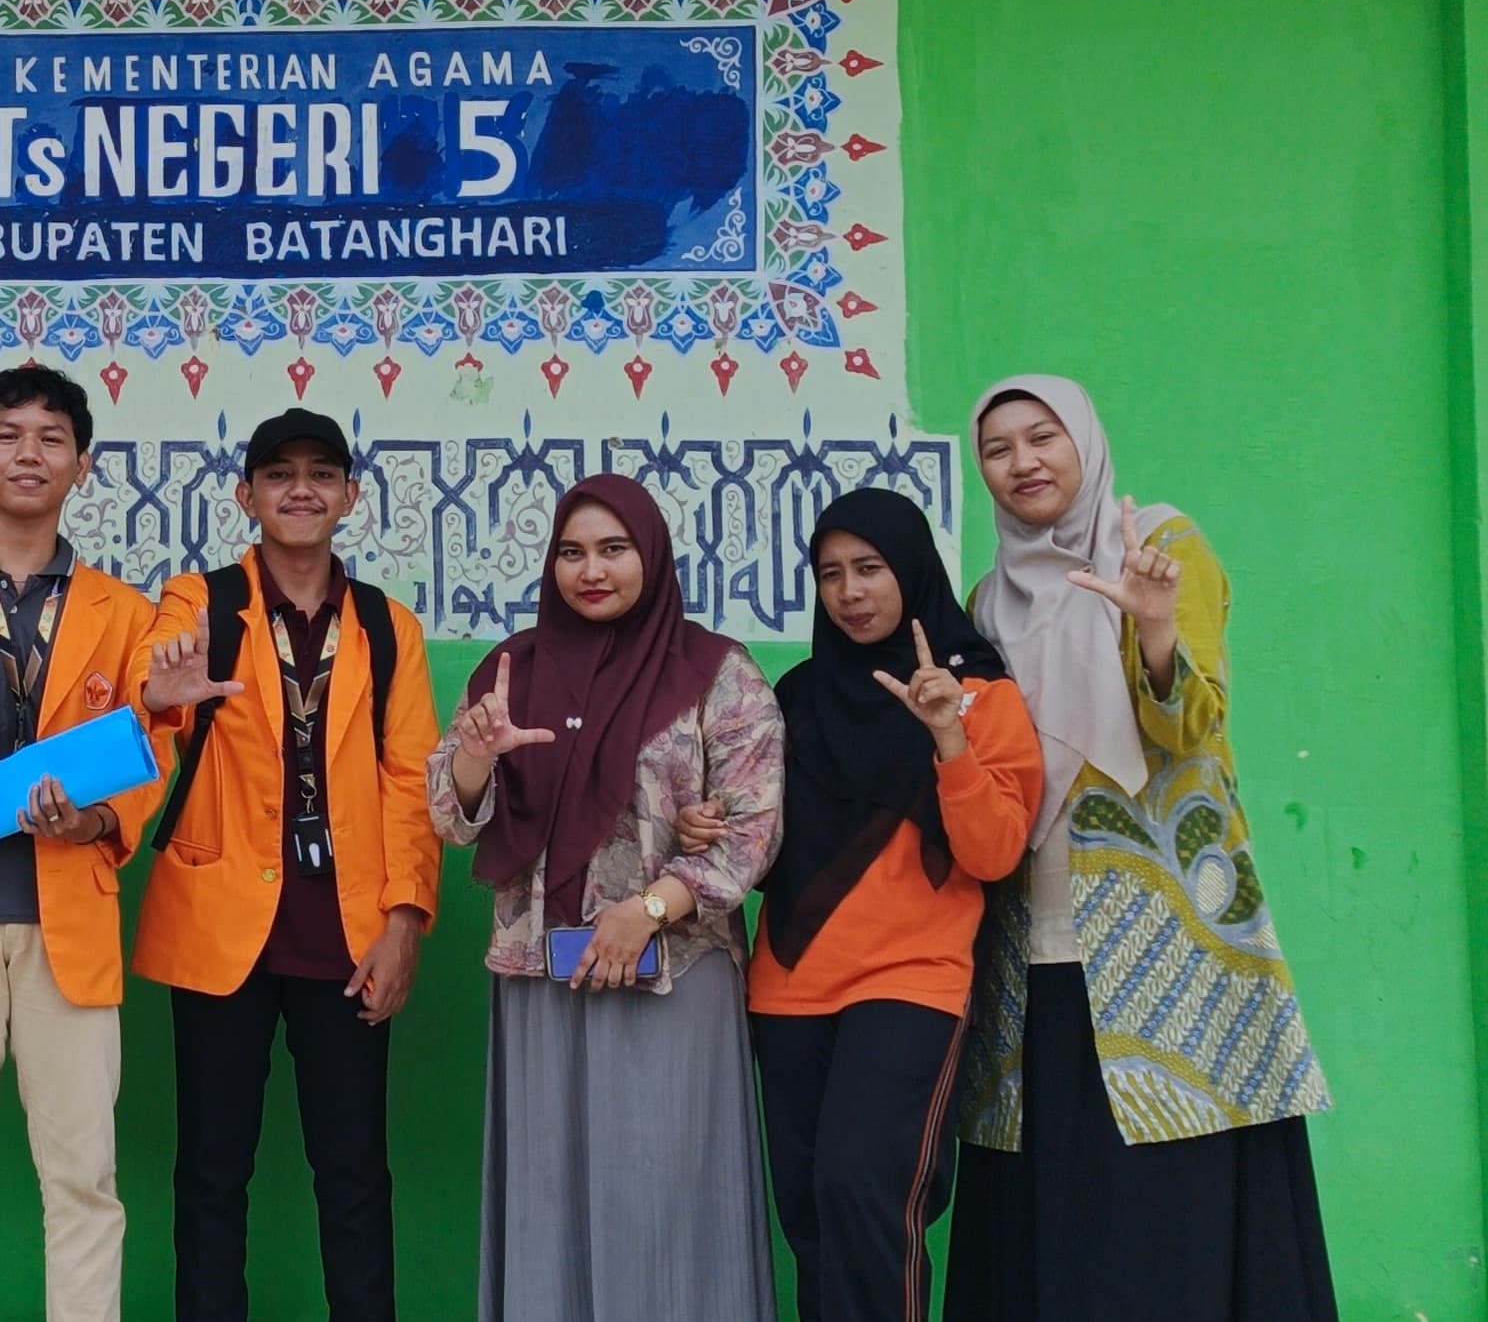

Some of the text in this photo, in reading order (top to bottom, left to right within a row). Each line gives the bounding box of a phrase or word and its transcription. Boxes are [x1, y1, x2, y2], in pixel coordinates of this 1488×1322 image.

[15, 50, 553, 93] KEMENTERIAN AGAMA
[84, 103, 380, 198] NEGERI
[457, 99, 518, 198] 5
[245, 215, 567, 263] BATANGHARI
